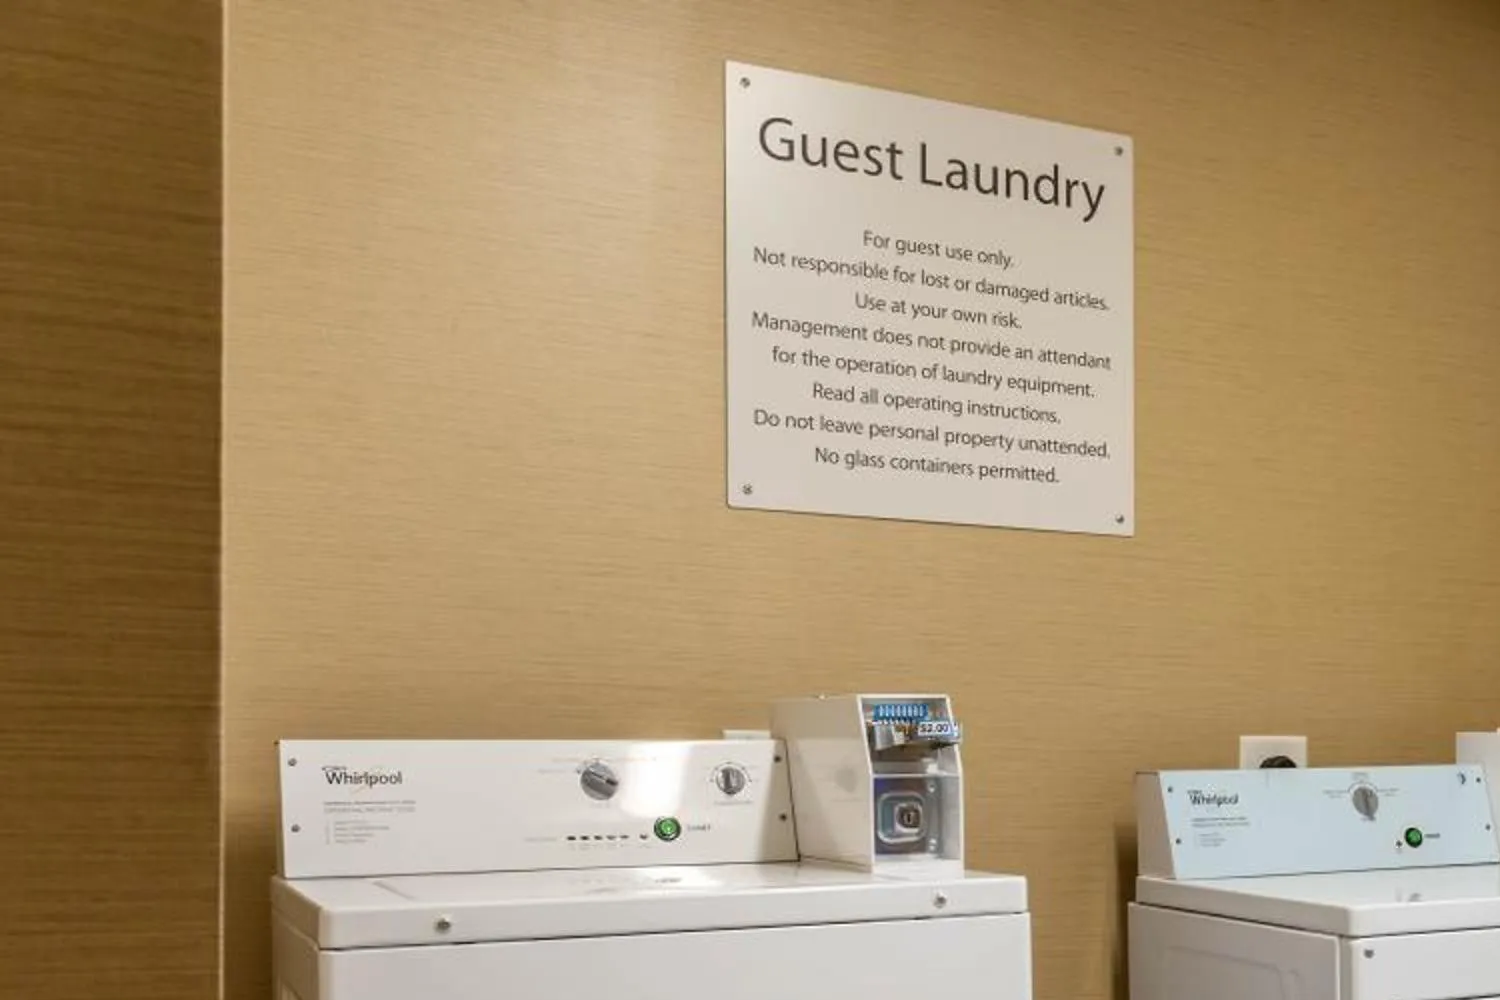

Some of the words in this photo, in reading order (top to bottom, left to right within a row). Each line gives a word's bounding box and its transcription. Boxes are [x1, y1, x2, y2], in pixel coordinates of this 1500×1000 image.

[758, 116, 904, 182] Guest
[919, 141, 1106, 224] Laundry
[863, 229, 891, 249] For
[895, 239, 941, 257] guest
[945, 246, 974, 263] use
[976, 249, 1014, 271] only.
[753, 245, 787, 268] Not
[791, 255, 889, 281] responsible
[892, 265, 916, 285] for
[921, 268, 950, 290] lost
[953, 278, 971, 292] or
[975, 277, 1050, 305] damaged
[1053, 291, 1110, 311] articles.
[854, 291, 887, 312] Use
[890, 299, 907, 315] at
[911, 303, 949, 320] your
[950, 309, 987, 325] own
[991, 311, 1023, 329] risk.
[751, 310, 868, 342] Management
[872, 326, 913, 347] does
[917, 335, 947, 351] not
[949, 339, 1011, 359] provide
[1014, 347, 1034, 361] an
[1037, 348, 1111, 371] attendant
[771, 345, 797, 365] for
[801, 348, 831, 369] the
[834, 356, 917, 379] operation
[920, 362, 940, 380] of
[941, 364, 1003, 392] laundry
[1006, 376, 1095, 399] equipment.
[812, 381, 856, 403] Read
[859, 387, 879, 405] all
[883, 392, 963, 418] operating
[966, 399, 1061, 425] instructions.
[753, 408, 781, 427] Do
[784, 415, 816, 431] not
[819, 415, 864, 436] leave
[868, 423, 939, 442] personal
[943, 431, 1015, 454] property
[1017, 438, 1111, 460] unattended.
[814, 446, 841, 465] No
[843, 449, 886, 471] glass
[889, 457, 975, 478] containers
[977, 464, 1060, 484] permitted.
[324, 770, 403, 790] Whirlpool
[1189, 792, 1240, 808] Whirlpool
